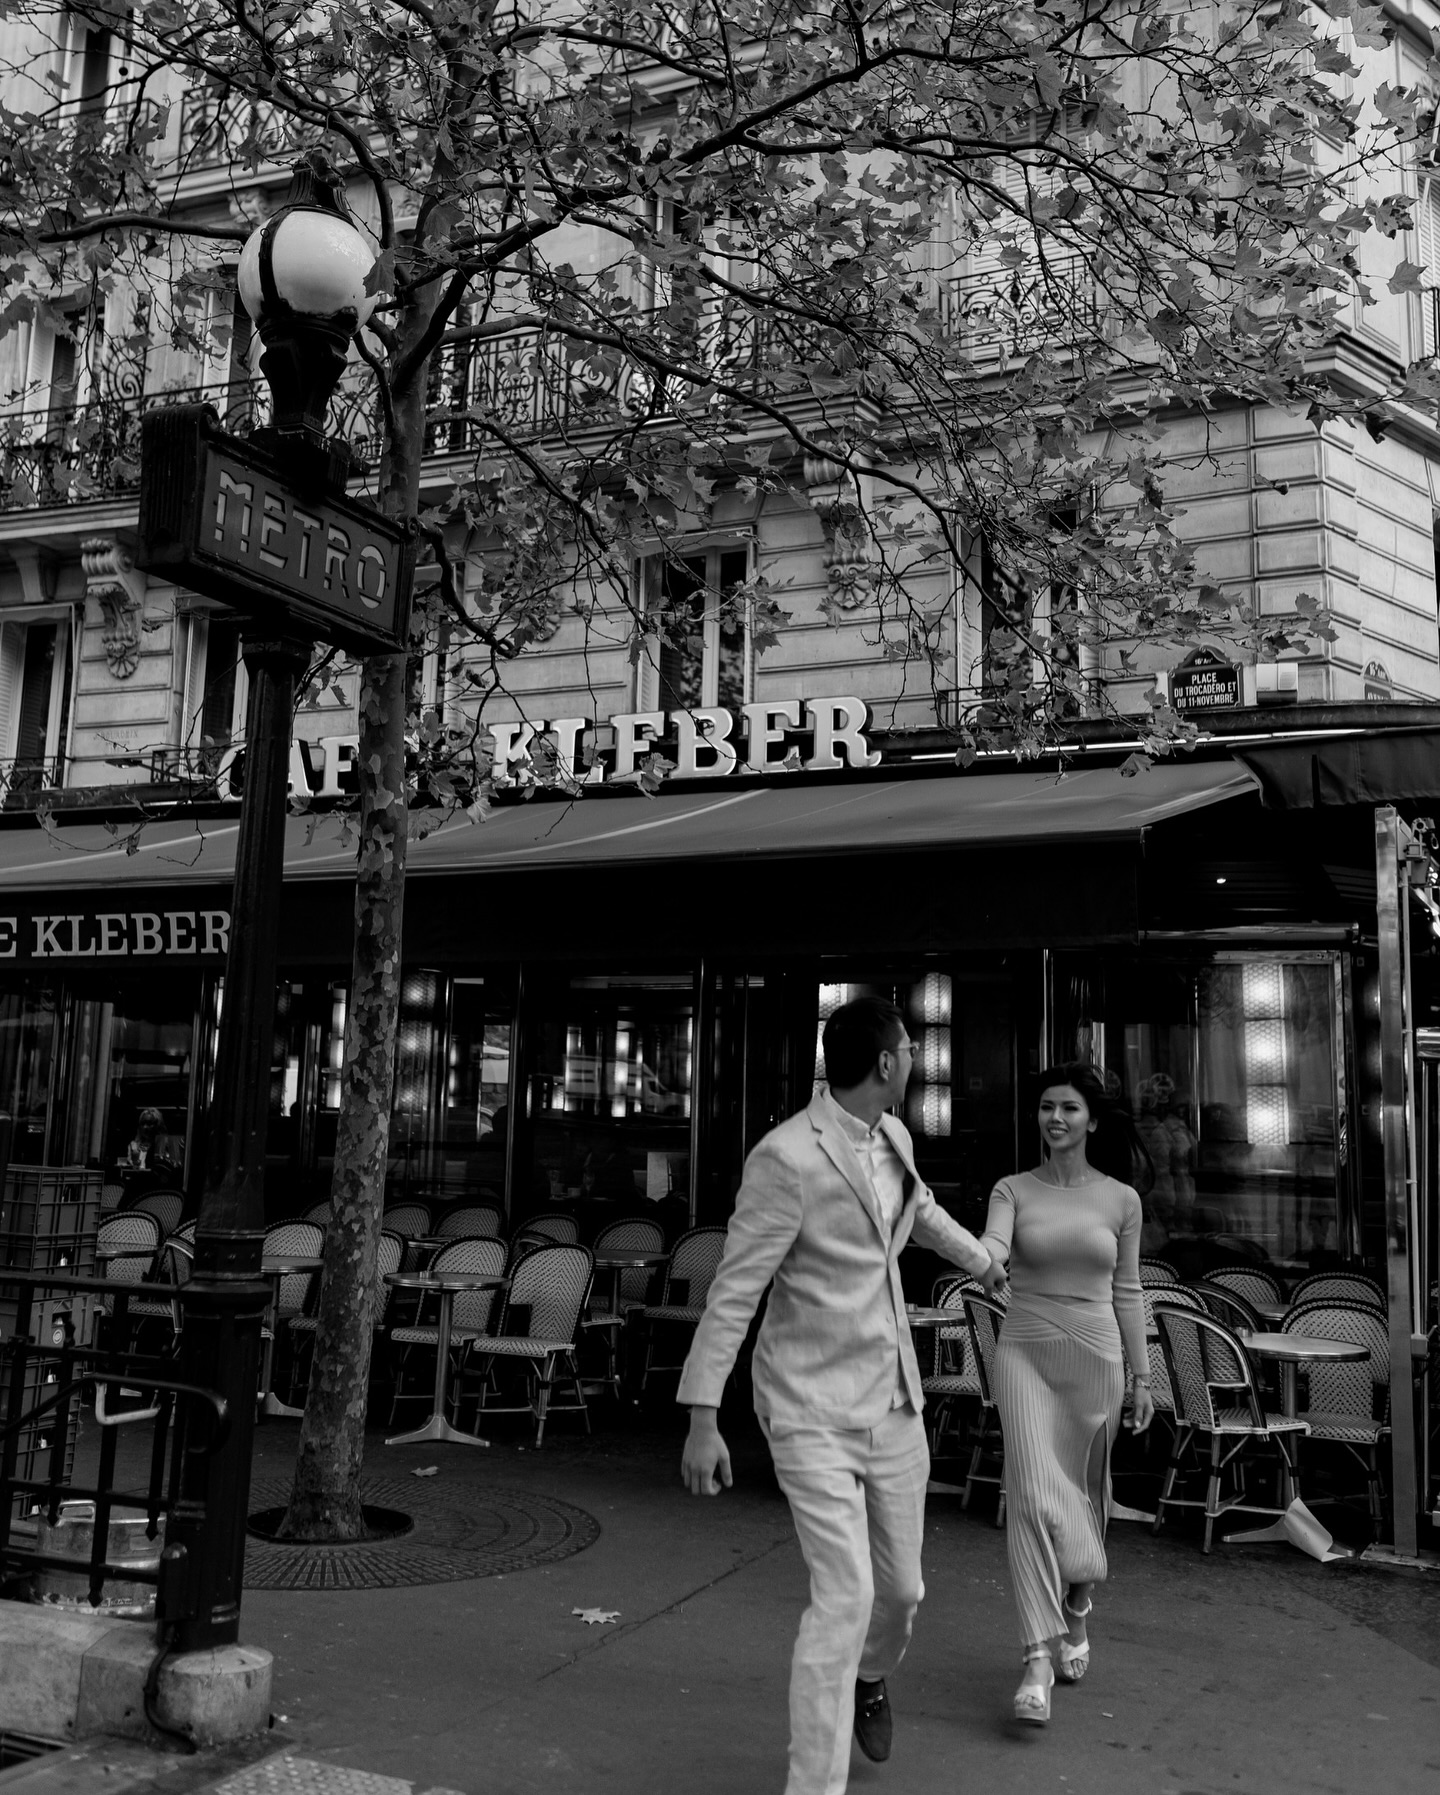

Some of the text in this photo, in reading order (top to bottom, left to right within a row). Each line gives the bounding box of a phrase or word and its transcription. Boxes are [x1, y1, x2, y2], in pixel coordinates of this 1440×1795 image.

[214, 469, 386, 609] METRO
[1173, 681, 1237, 698] DU TROCADERO ET
[1191, 672, 1218, 685] PLACE
[1177, 697, 1187, 708] DU
[486, 694, 882, 788] KLEBER
[31, 910, 232, 957] KLEBER
